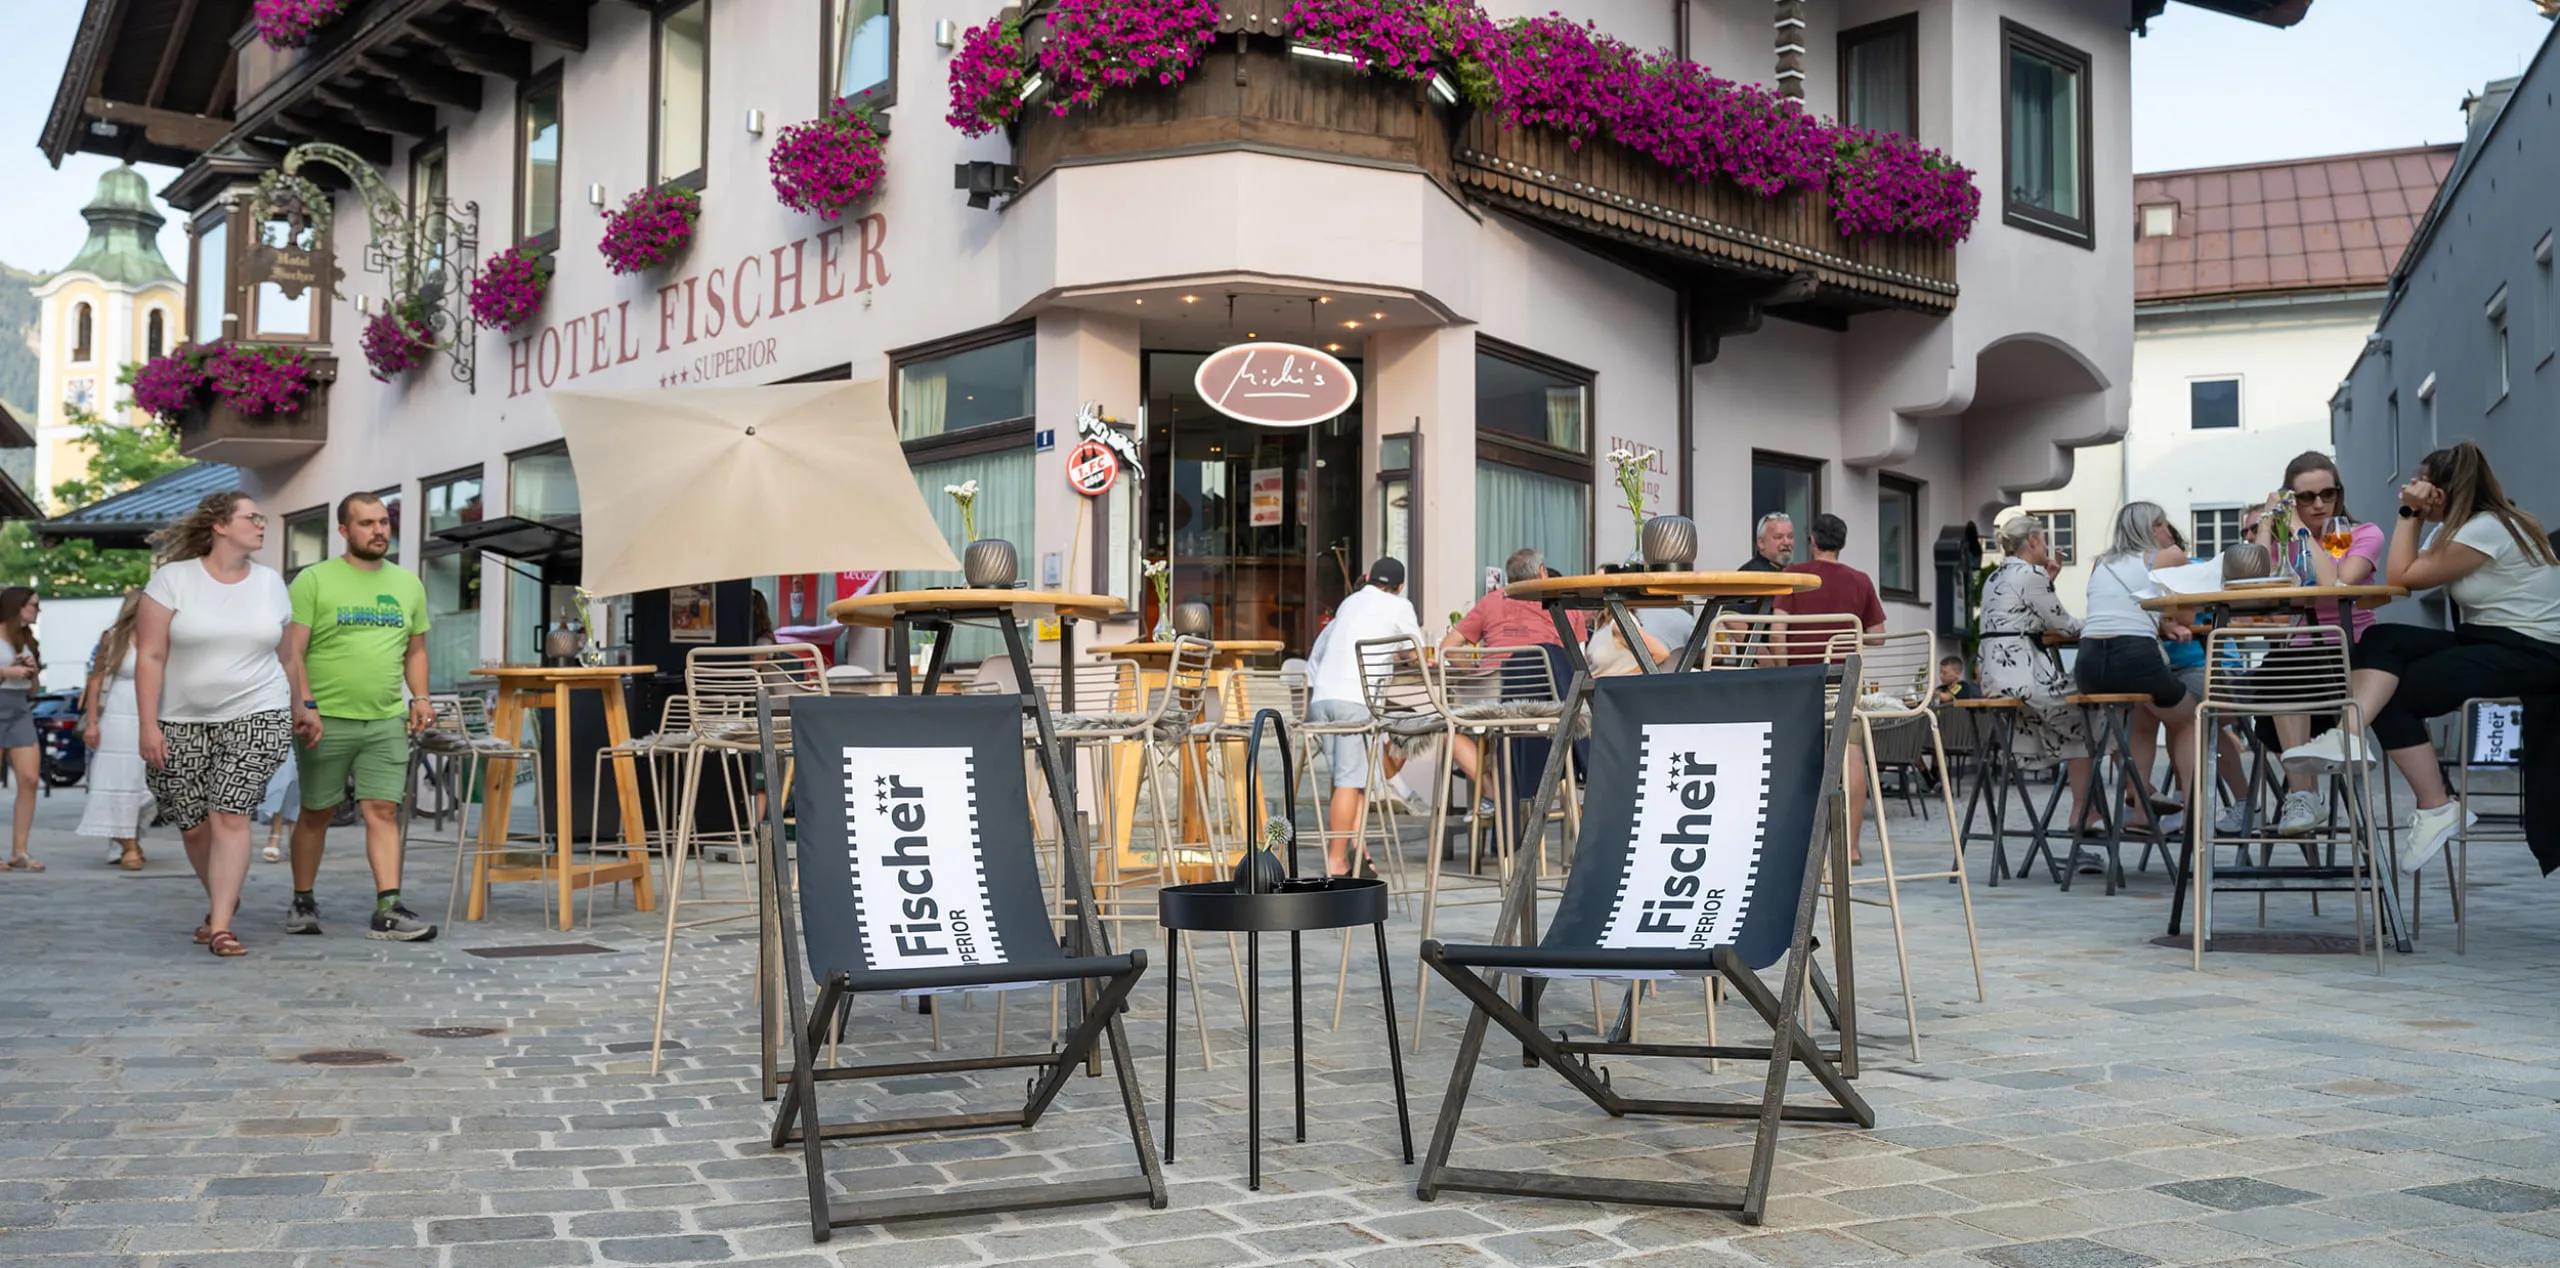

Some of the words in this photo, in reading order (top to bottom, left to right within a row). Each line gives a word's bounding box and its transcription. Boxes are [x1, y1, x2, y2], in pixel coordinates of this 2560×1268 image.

[507, 300, 640, 398] HOTEL
[656, 212, 891, 353] FISCHER
[693, 337, 778, 383] SUPERIOR
[1216, 349, 1327, 408] Michi's
[881, 774, 949, 957] Fischer
[1636, 751, 1718, 933] Fischer
[949, 909, 980, 967] PERIOR
